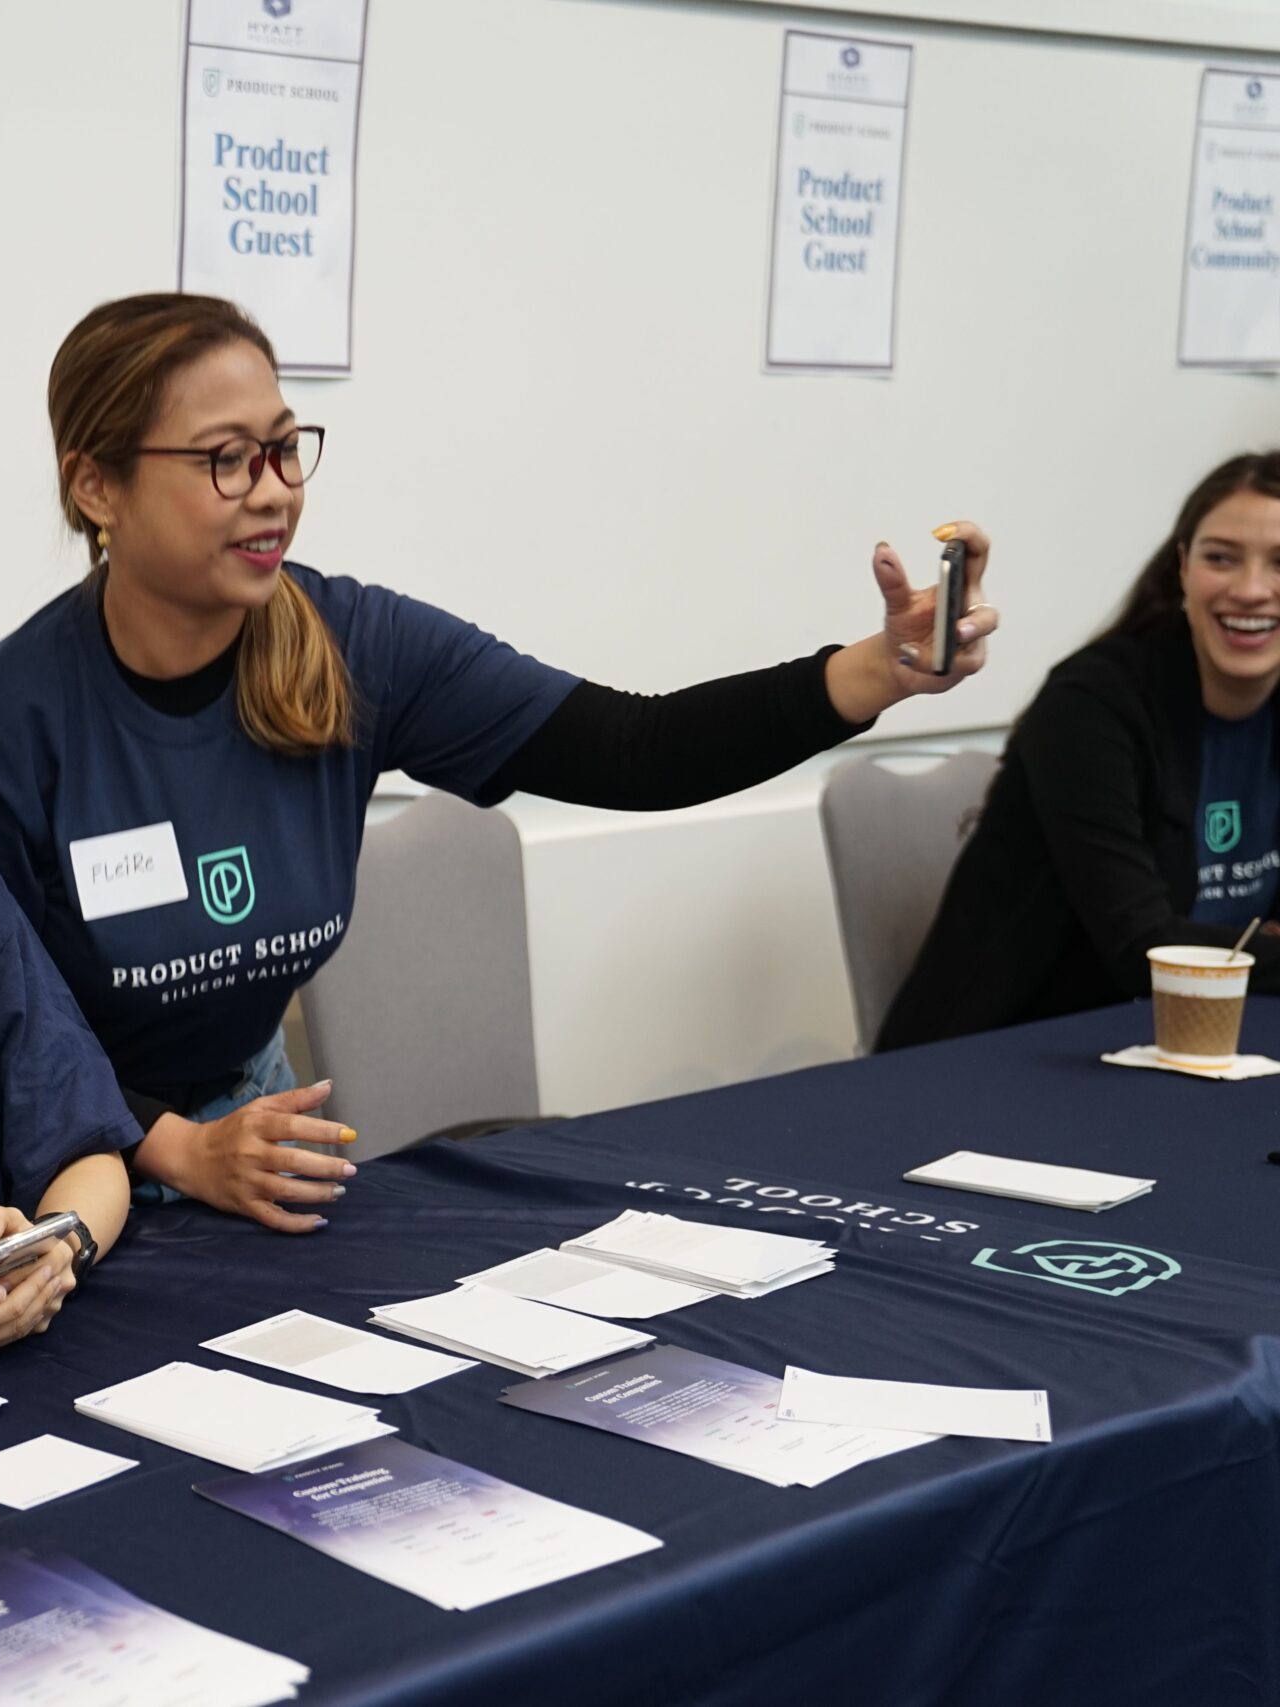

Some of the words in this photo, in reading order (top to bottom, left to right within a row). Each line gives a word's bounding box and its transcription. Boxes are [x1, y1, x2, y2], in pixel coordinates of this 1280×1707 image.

[247, 22, 303, 38] HYATT
[227, 79, 286, 97] PRODUCT
[289, 86, 340, 103] SCHOOL
[213, 132, 331, 176] Product
[223, 176, 319, 217] School
[797, 166, 884, 204] Product
[228, 219, 315, 257] Guest
[801, 204, 874, 239] School
[803, 240, 867, 274] Guest
[111, 943, 242, 989] PRODUCT
[255, 913, 344, 960] SCHOOL
[161, 974, 236, 1005] SILICON
[247, 957, 312, 982] VALLEY
[725, 1178, 980, 1235] SCHOOL
